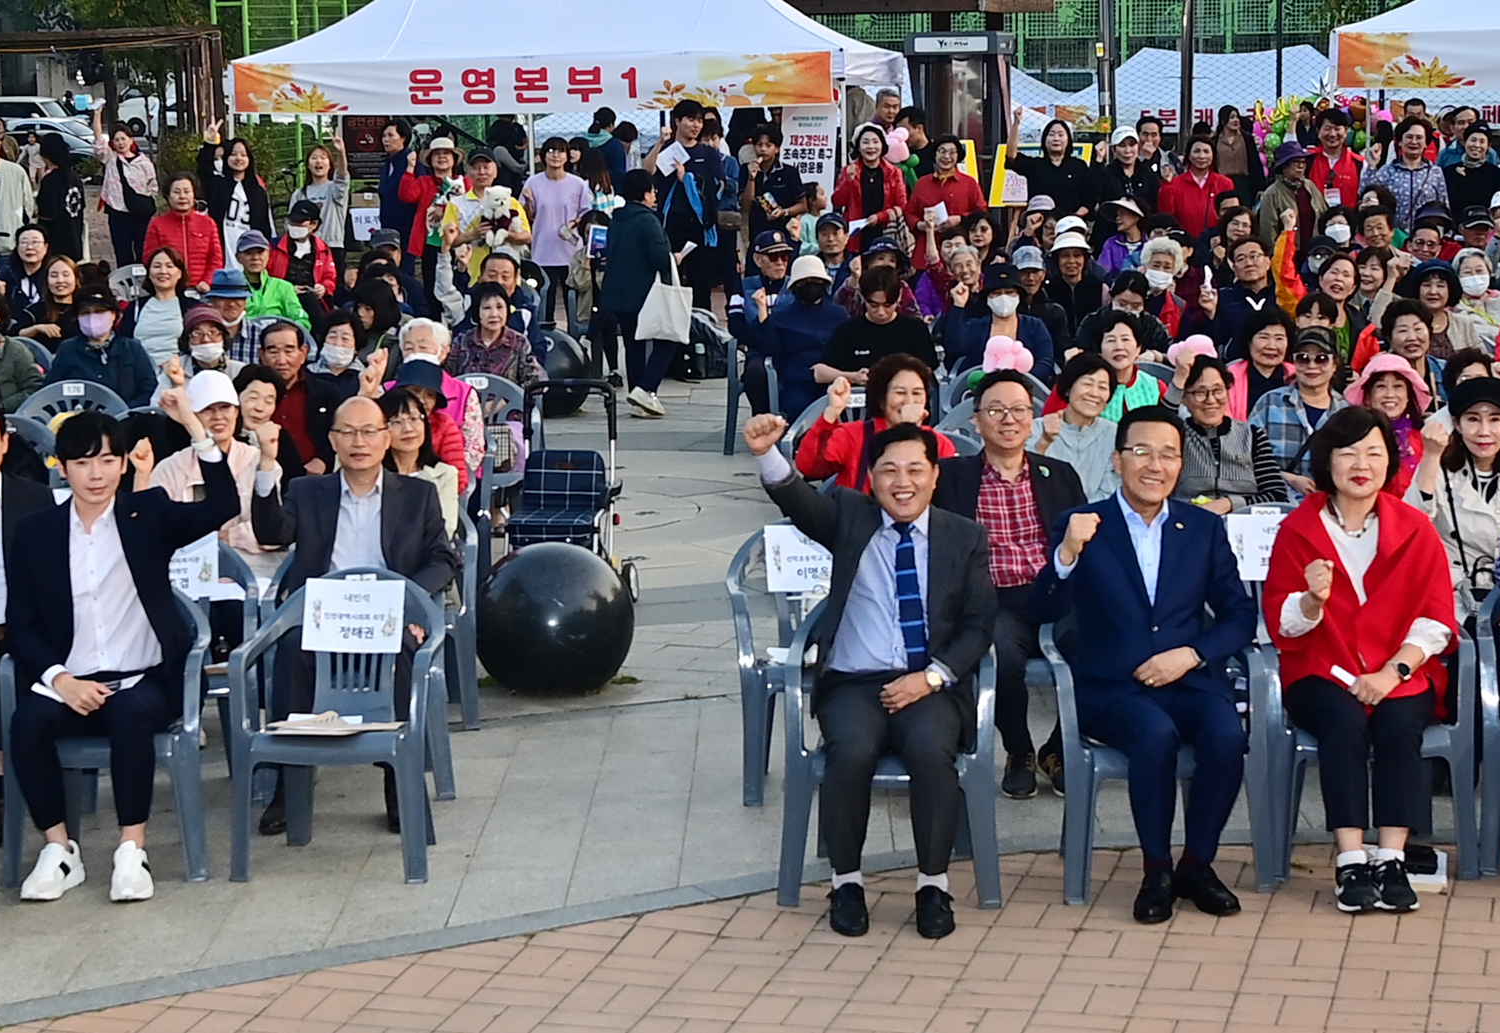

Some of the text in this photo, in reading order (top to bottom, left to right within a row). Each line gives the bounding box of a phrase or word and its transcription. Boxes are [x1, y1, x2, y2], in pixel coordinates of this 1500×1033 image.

[789, 134, 829, 147] 제2경인선
[783, 148, 816, 160] 조속추진
[344, 593, 371, 603] 내빈석
